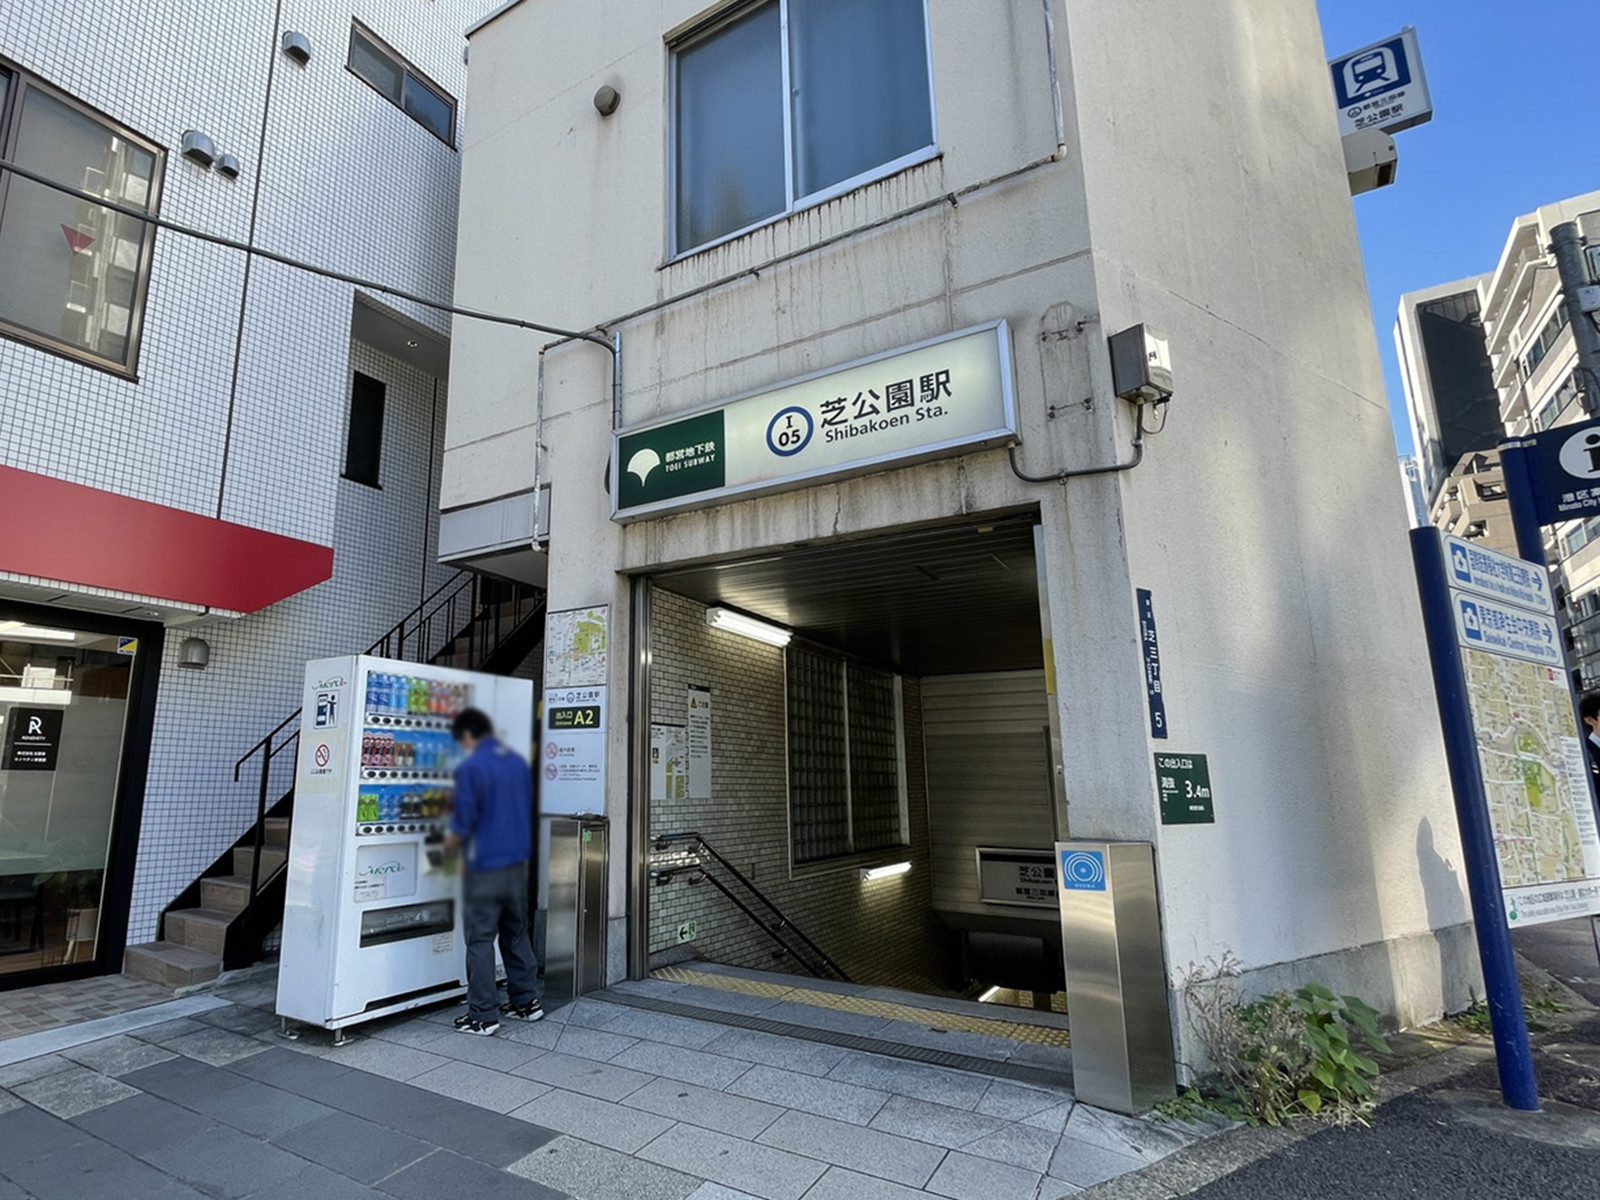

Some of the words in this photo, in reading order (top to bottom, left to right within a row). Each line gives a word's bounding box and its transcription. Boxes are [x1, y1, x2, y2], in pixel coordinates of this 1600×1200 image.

[820, 369, 952, 428] 芝公園駅
[785, 415, 793, 428] I
[825, 413, 909, 443] Shibakoen
[915, 405, 948, 421] Sta.
[779, 429, 801, 447] 05
[665, 441, 716, 463] 都営地下鉄
[665, 463, 682, 472] TOEI
[683, 454, 716, 468] SUBWAY
[1582, 498, 1597, 507] City
[574, 710, 594, 725] A2
[1154, 712, 1163, 728] 5
[1184, 780, 1210, 798] 3.4m
